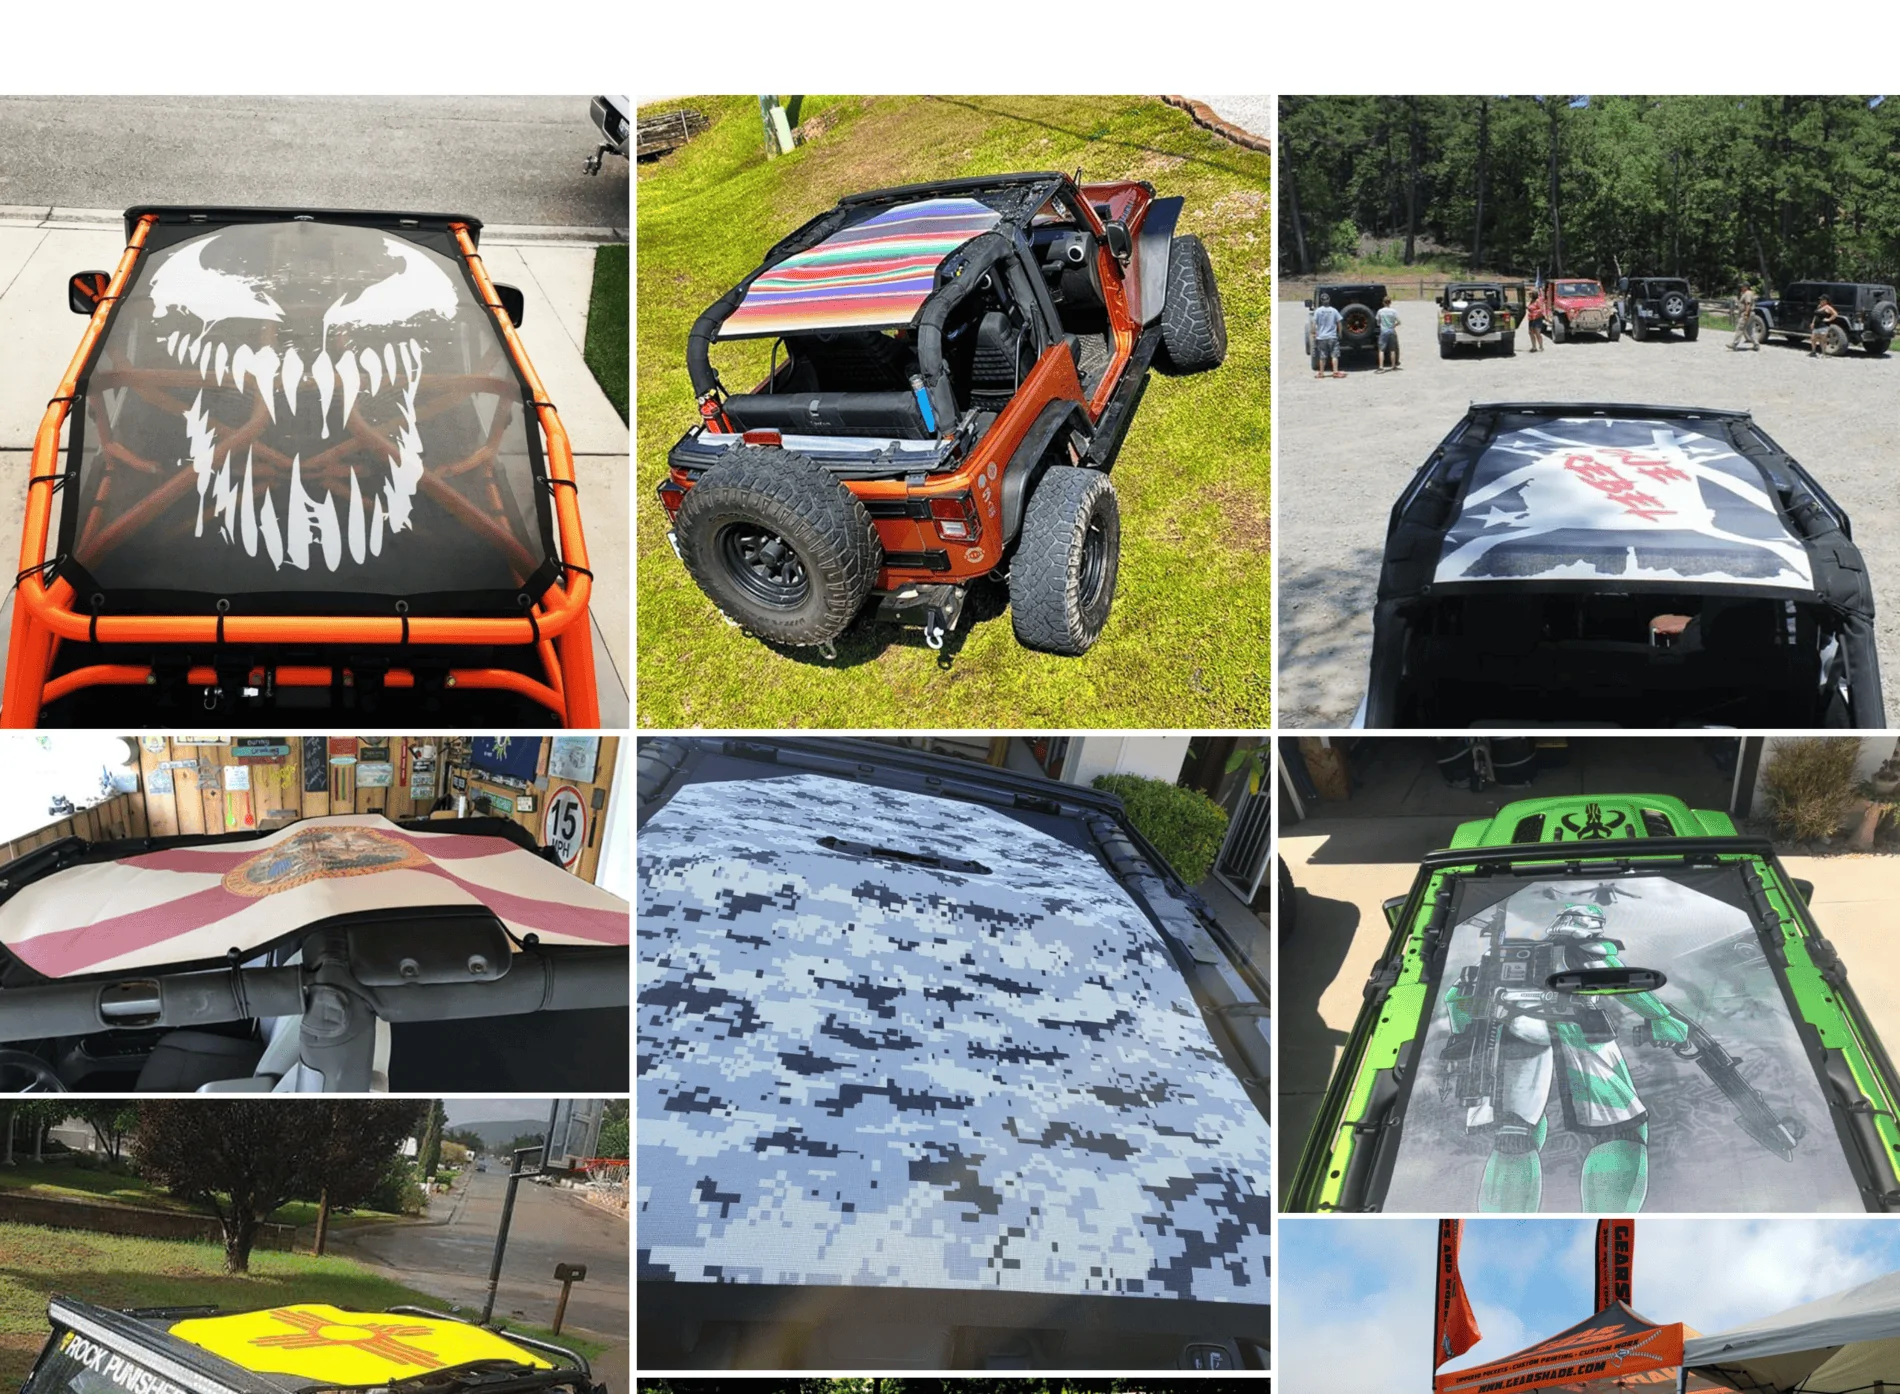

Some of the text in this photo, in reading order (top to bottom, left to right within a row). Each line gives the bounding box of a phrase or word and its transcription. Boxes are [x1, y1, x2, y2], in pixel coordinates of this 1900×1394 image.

[551, 799, 578, 841] 15
[552, 838, 571, 859] MPH
[1443, 1245, 1453, 1274] AND
[65, 1335, 108, 1372] ROCK
[1482, 1366, 1509, 1377] POCKETS
[1512, 1358, 1539, 1370] CUSTOM
[1540, 1353, 1574, 1364] PRINTING
[1578, 1344, 1613, 1357] CUSTOM
[1614, 1339, 1640, 1349] WORK
[1478, 1361, 1607, 1393] WWW.GEARSHADE.COM
